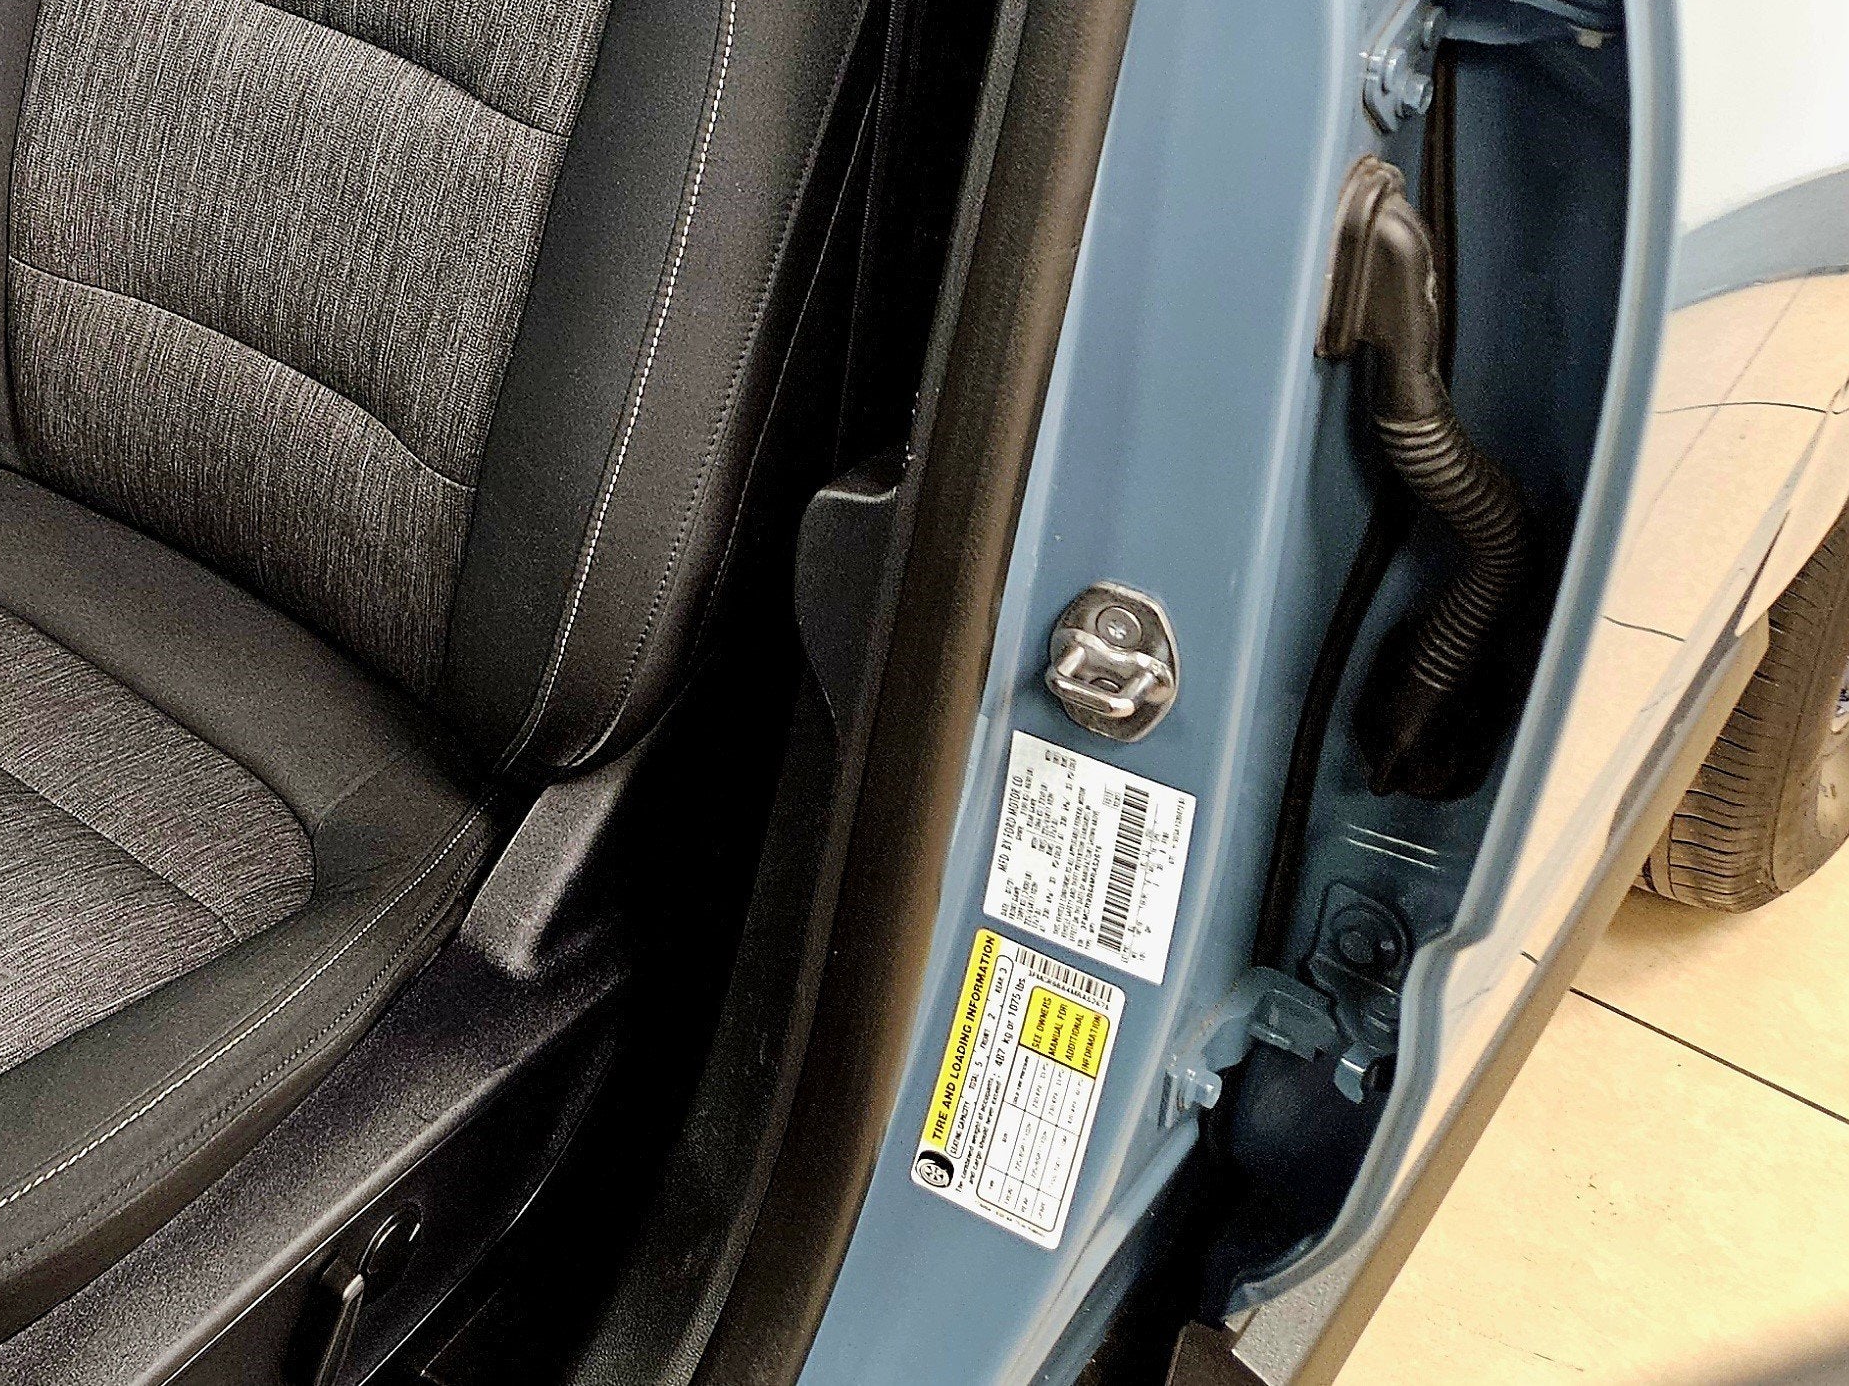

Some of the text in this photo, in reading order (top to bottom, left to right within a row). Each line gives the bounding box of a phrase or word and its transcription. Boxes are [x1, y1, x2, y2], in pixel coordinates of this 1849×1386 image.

[1006, 787, 1021, 816] MOTOR
[1001, 838, 1012, 850] BY
[1002, 815, 1016, 839] FORD
[931, 934, 996, 1141] TIRE AND LOADING INFORMATION
[1001, 1030, 1013, 1045] kg
[1007, 991, 1021, 1017] 1075
[1031, 1032, 1042, 1049] SEE
[1047, 1021, 1063, 1056] MANUAL
[1057, 1002, 1068, 1020] FOR
[1064, 1011, 1084, 1061] ADDITIONAL
[1079, 1013, 1102, 1071] INFORMATION
